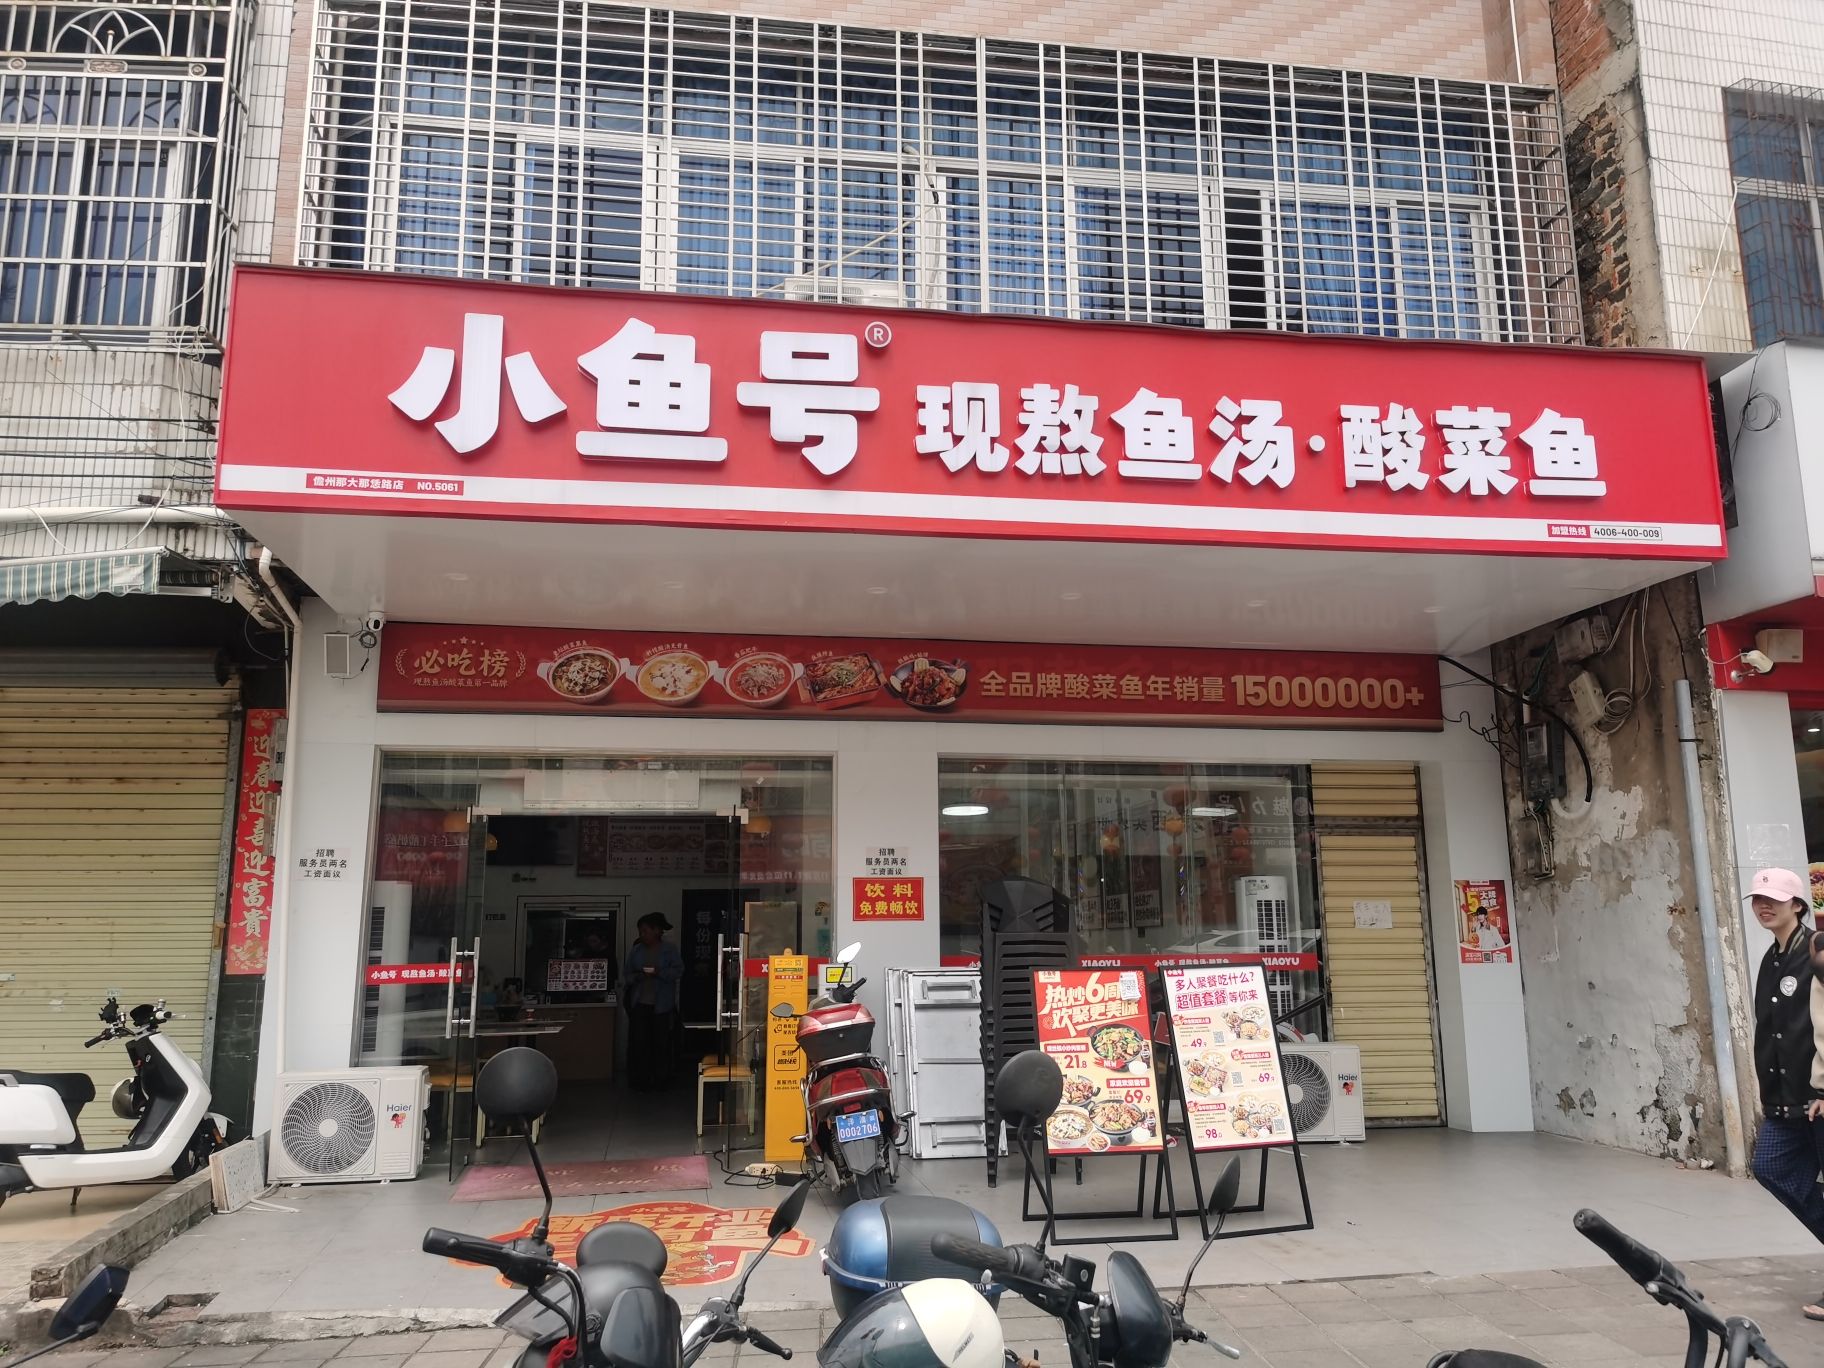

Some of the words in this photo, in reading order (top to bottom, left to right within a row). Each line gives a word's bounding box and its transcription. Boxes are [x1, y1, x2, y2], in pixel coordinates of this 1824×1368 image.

[387, 313, 880, 477] 小鱼号
[915, 380, 1607, 498] 现熬鱼汤·酸菜鱼
[417, 481, 459, 492] NO.5061
[1551, 525, 1587, 537] 加盟热线
[1594, 527, 1660, 538] 4006-400-009
[413, 647, 510, 678] 必吃榜
[979, 670, 1226, 703] 全品牌酸菜鱼年销量
[1231, 674, 1425, 709] 15000000+
[315, 848, 335, 858] 招聘
[879, 847, 896, 857] 招聘
[299, 858, 348, 869] 服务员两名
[865, 857, 907, 867] 服务员两名
[303, 869, 341, 879] 工资面议
[871, 867, 903, 876] 工资面议
[859, 900, 919, 915] 免费畅饮
[1261, 956, 1300, 966] XIAOYU
[370, 970, 397, 980] 小鱼号
[1039, 971, 1122, 1015] 热炒6周
[1177, 990, 1228, 1011] 超值套餐
[1228, 989, 1259, 1004] 等你来
[1063, 1055, 1088, 1069] 21.8
[1338, 1074, 1358, 1082] Haier
[1123, 1089, 1152, 1104] 69.9
[386, 1103, 412, 1113] Haier
[839, 1122, 878, 1139] 0002706
